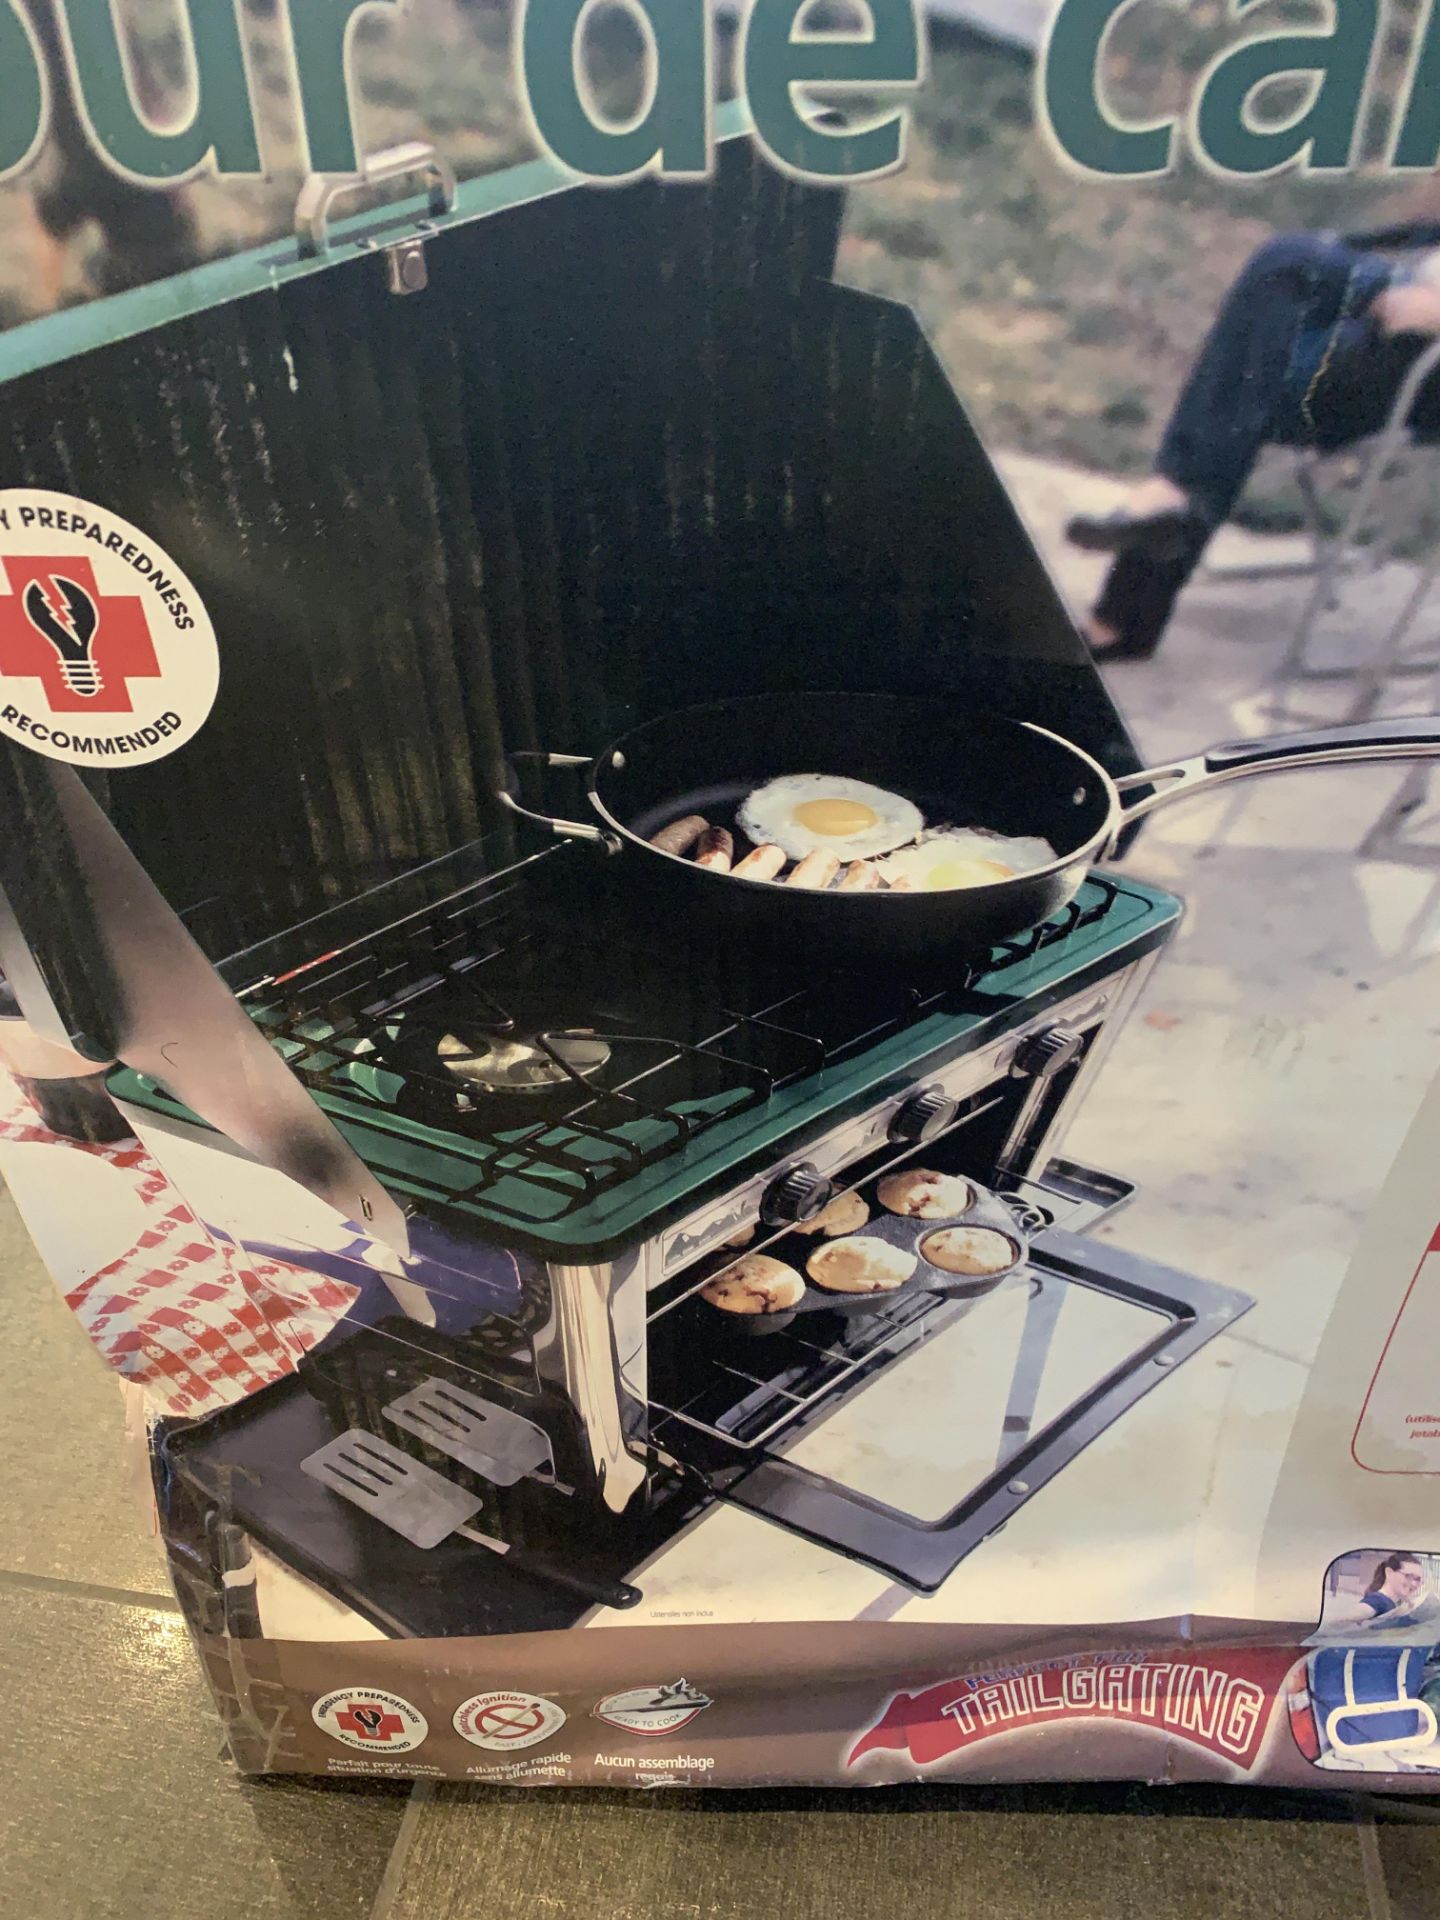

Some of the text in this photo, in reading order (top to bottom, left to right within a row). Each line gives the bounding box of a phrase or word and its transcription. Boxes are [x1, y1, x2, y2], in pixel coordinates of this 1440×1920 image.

[1035, 0, 1440, 181] ca
[18, 506, 195, 630] PREPAREDNESS
[1, 704, 182, 755] RECOMMENDED
[357, 1691, 420, 1724] PREPAREDNESS
[476, 1693, 527, 1706] Ignition
[941, 1662, 1266, 1755] TAILGATING
[642, 1720, 655, 1728] TO
[339, 1733, 411, 1752] RECOMMENDED
[466, 1751, 572, 1774] Allumage rapide
[506, 1765, 566, 1780] allumette
[593, 1753, 715, 1771] Aucun assemblage
